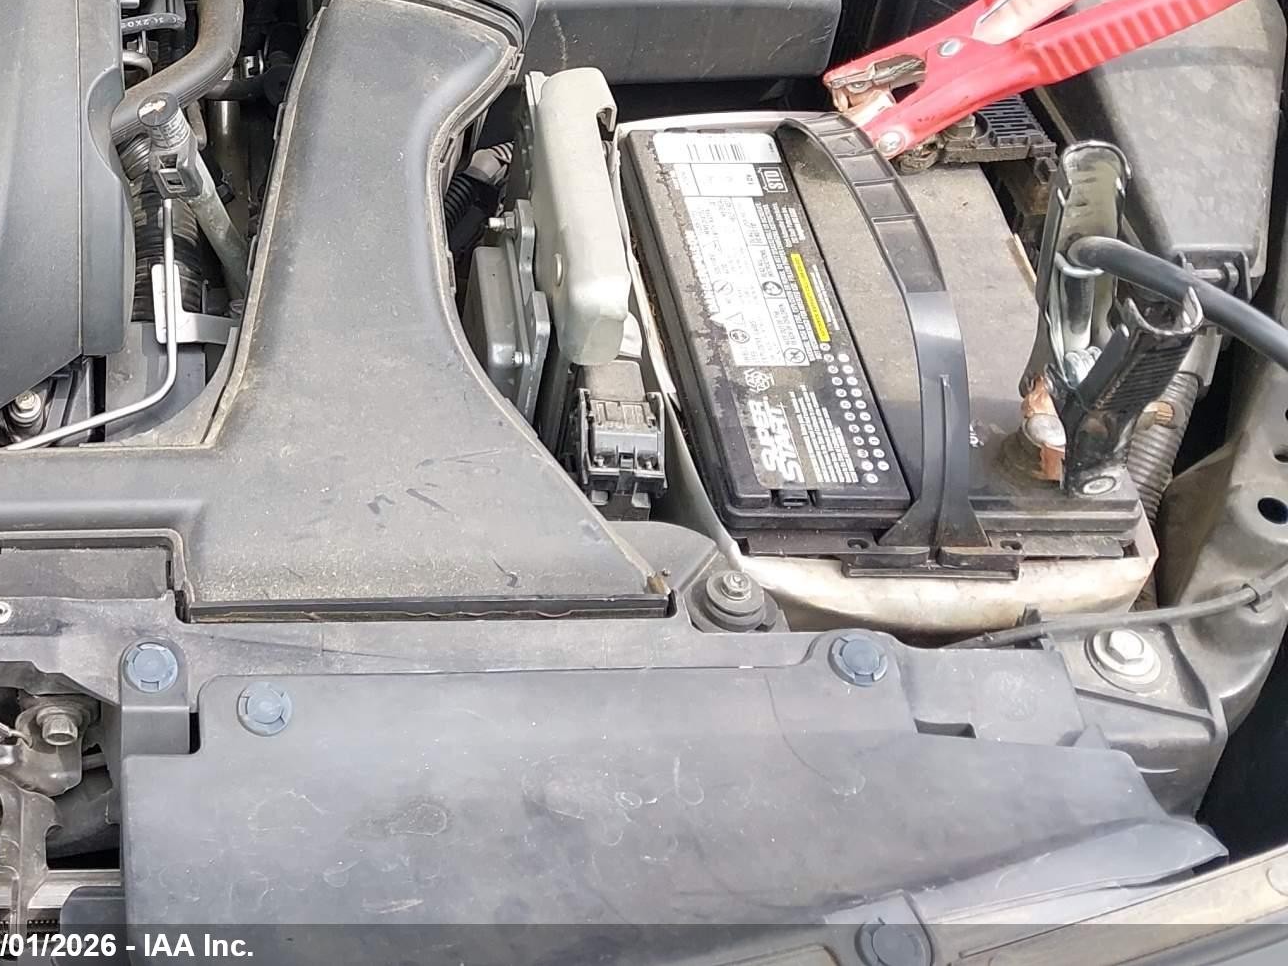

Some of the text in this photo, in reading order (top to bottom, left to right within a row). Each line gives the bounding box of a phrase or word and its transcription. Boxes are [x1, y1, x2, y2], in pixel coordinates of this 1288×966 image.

[765, 169, 785, 191] STD
[747, 398, 780, 471] SUPER
[763, 402, 805, 483] START
